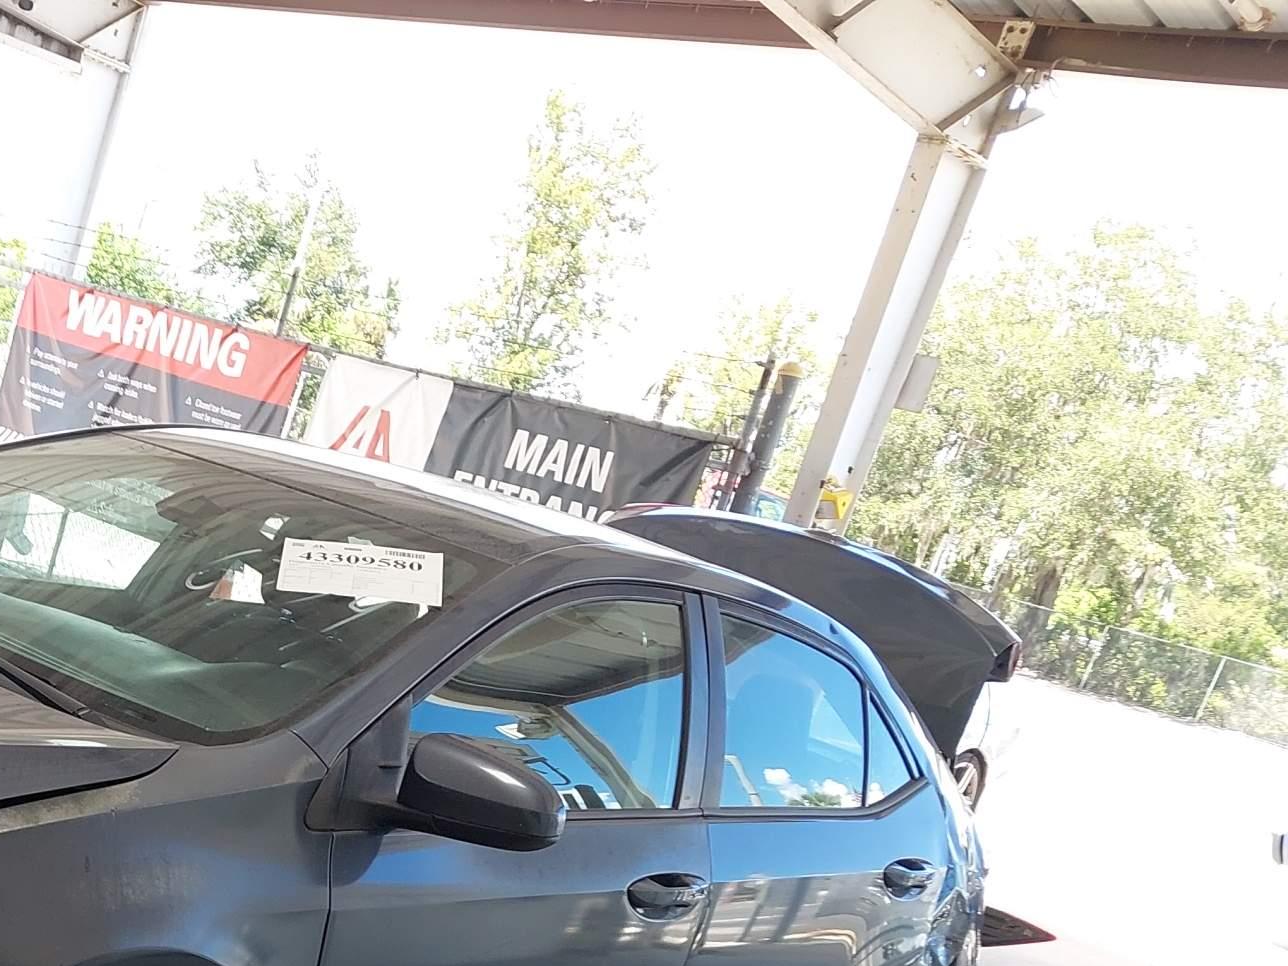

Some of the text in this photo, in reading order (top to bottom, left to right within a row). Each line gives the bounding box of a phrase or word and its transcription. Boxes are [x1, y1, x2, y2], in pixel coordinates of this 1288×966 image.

[64, 288, 250, 378] WARNING
[503, 429, 615, 493] MAIN
[297, 551, 423, 572] 43309580
